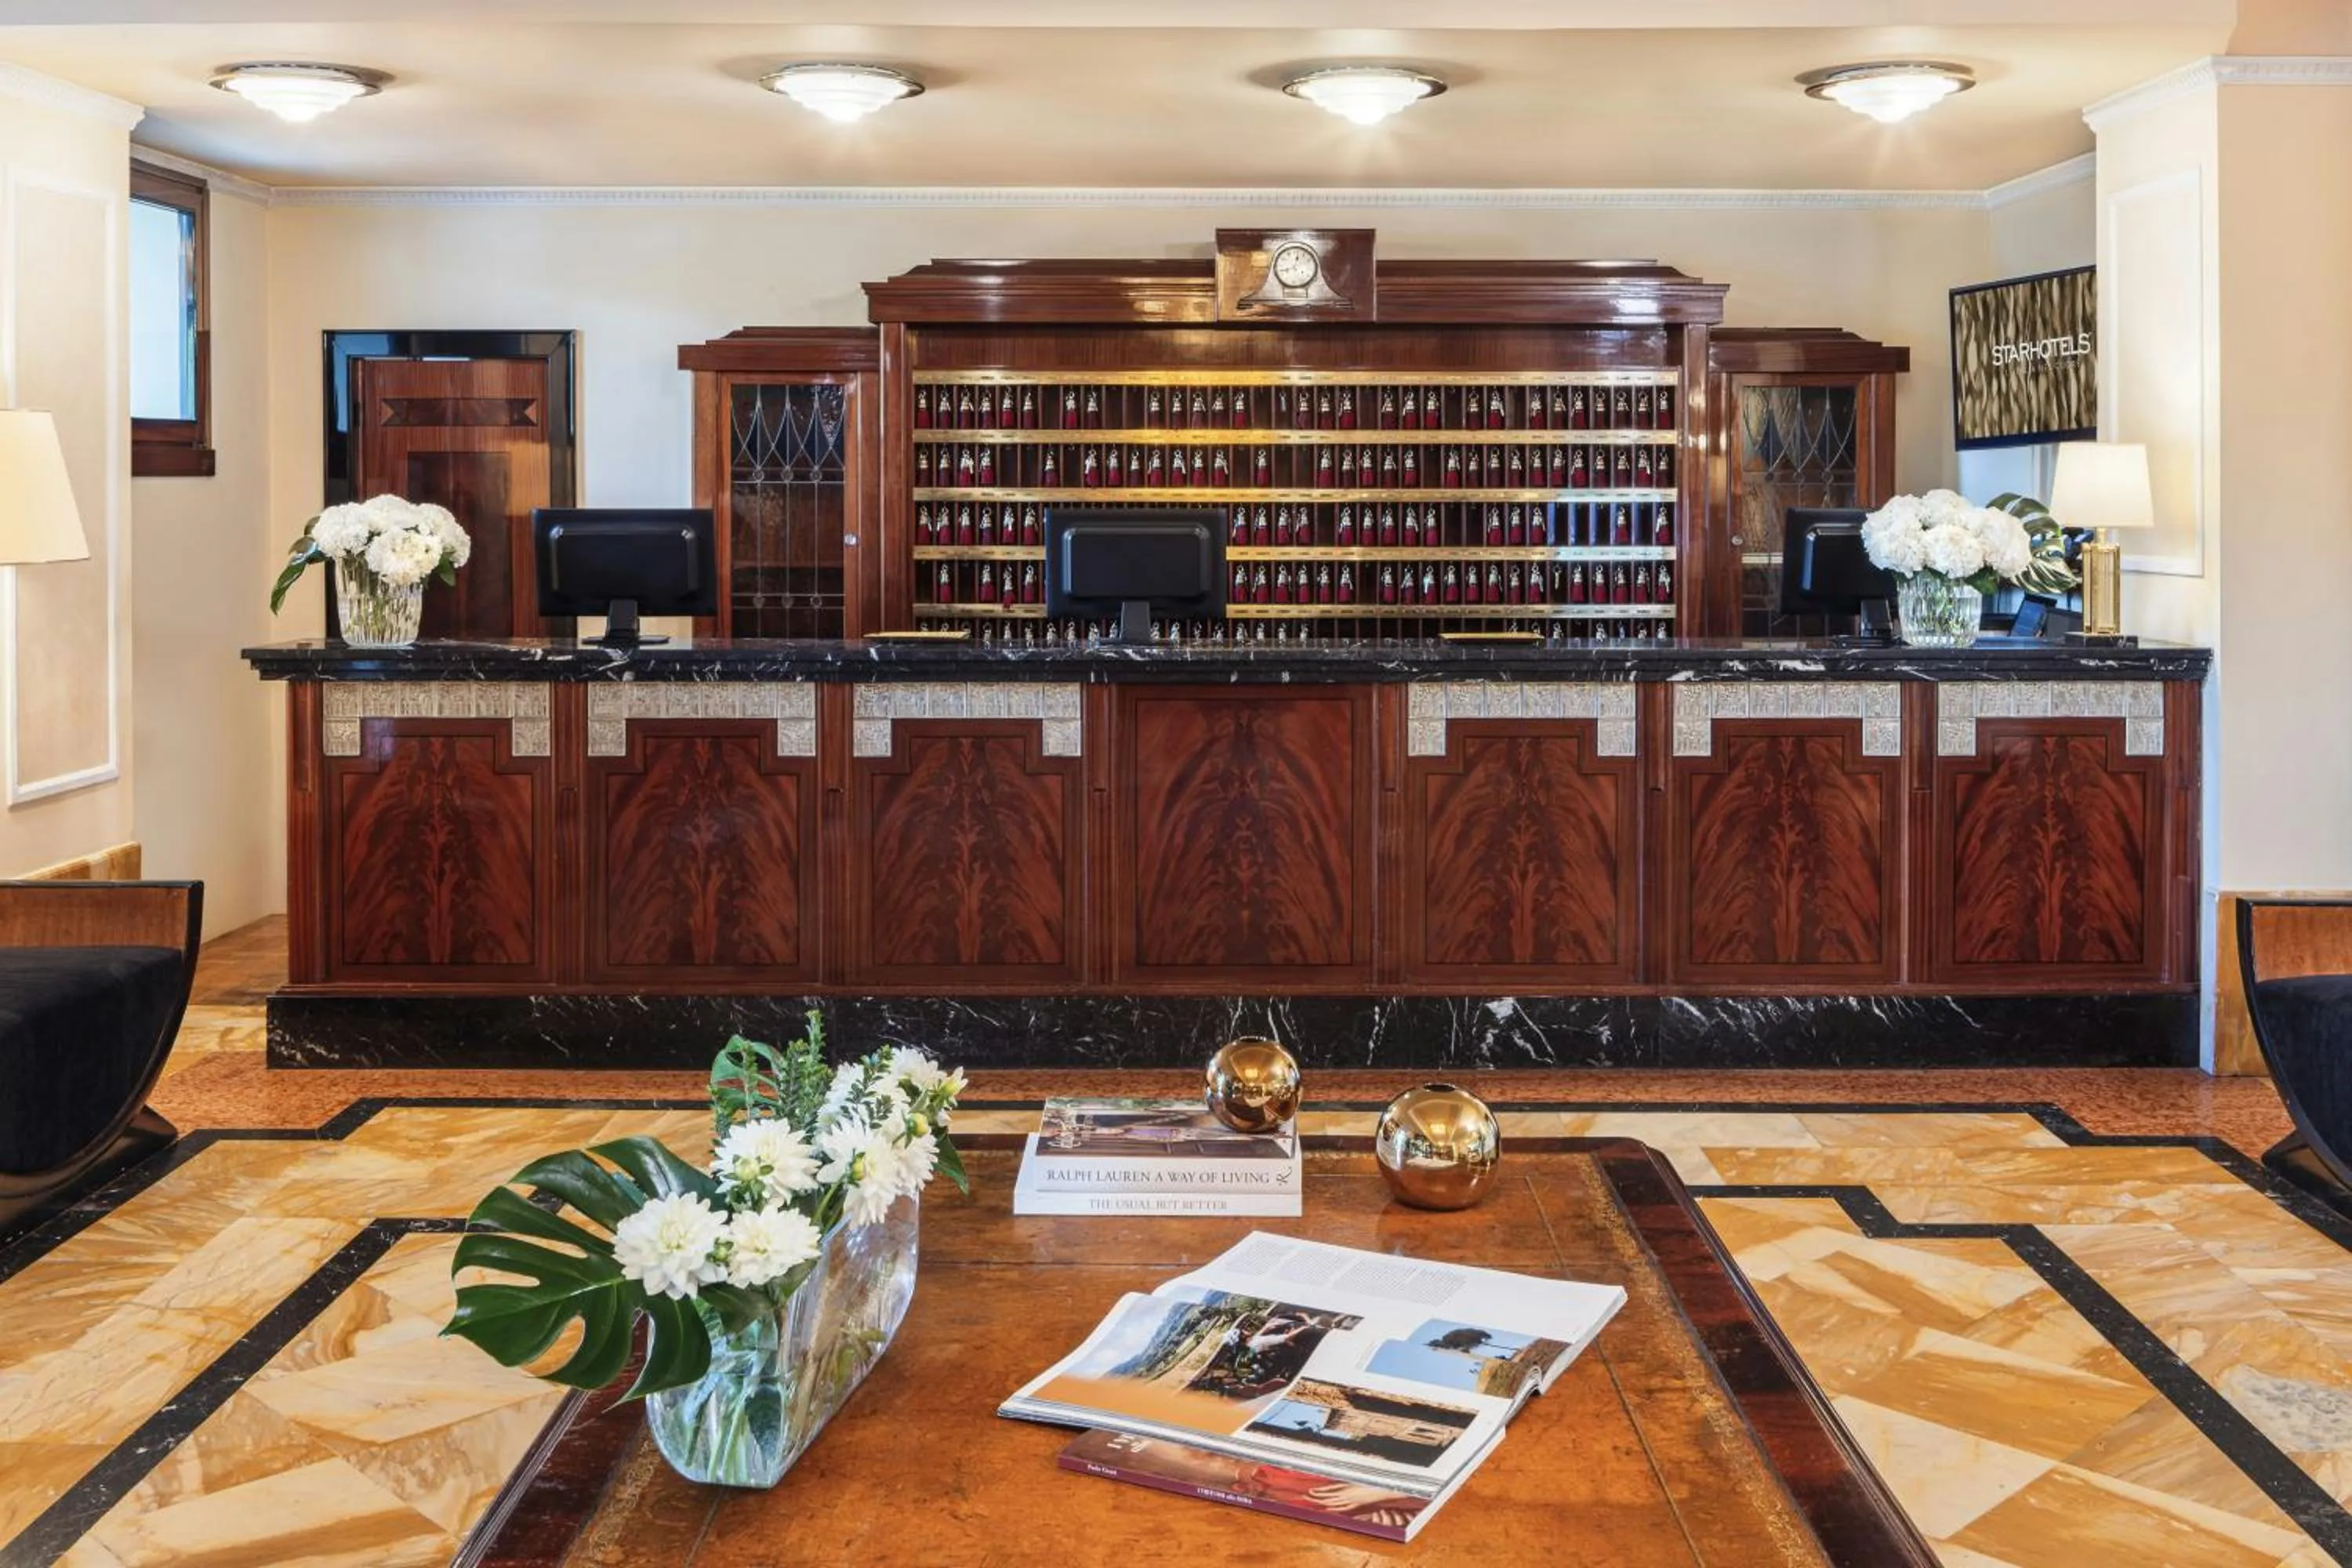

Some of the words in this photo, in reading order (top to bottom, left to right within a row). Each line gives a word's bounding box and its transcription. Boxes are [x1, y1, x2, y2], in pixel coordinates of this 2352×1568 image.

[1992, 333, 2092, 366] STARHOTELS
[1047, 1170, 1091, 1181] RALPH
[1097, 1171, 1150, 1182] LAUREN
[1155, 1172, 1163, 1182] A
[1167, 1172, 1195, 1183] WAY
[1200, 1173, 1218, 1183] OF
[1221, 1172, 1270, 1183] LIVING
[1090, 1200, 1110, 1209] THE
[1116, 1200, 1153, 1209] USUAL
[1156, 1200, 1179, 1209] BUT
[1182, 1200, 1228, 1210] BETTER
